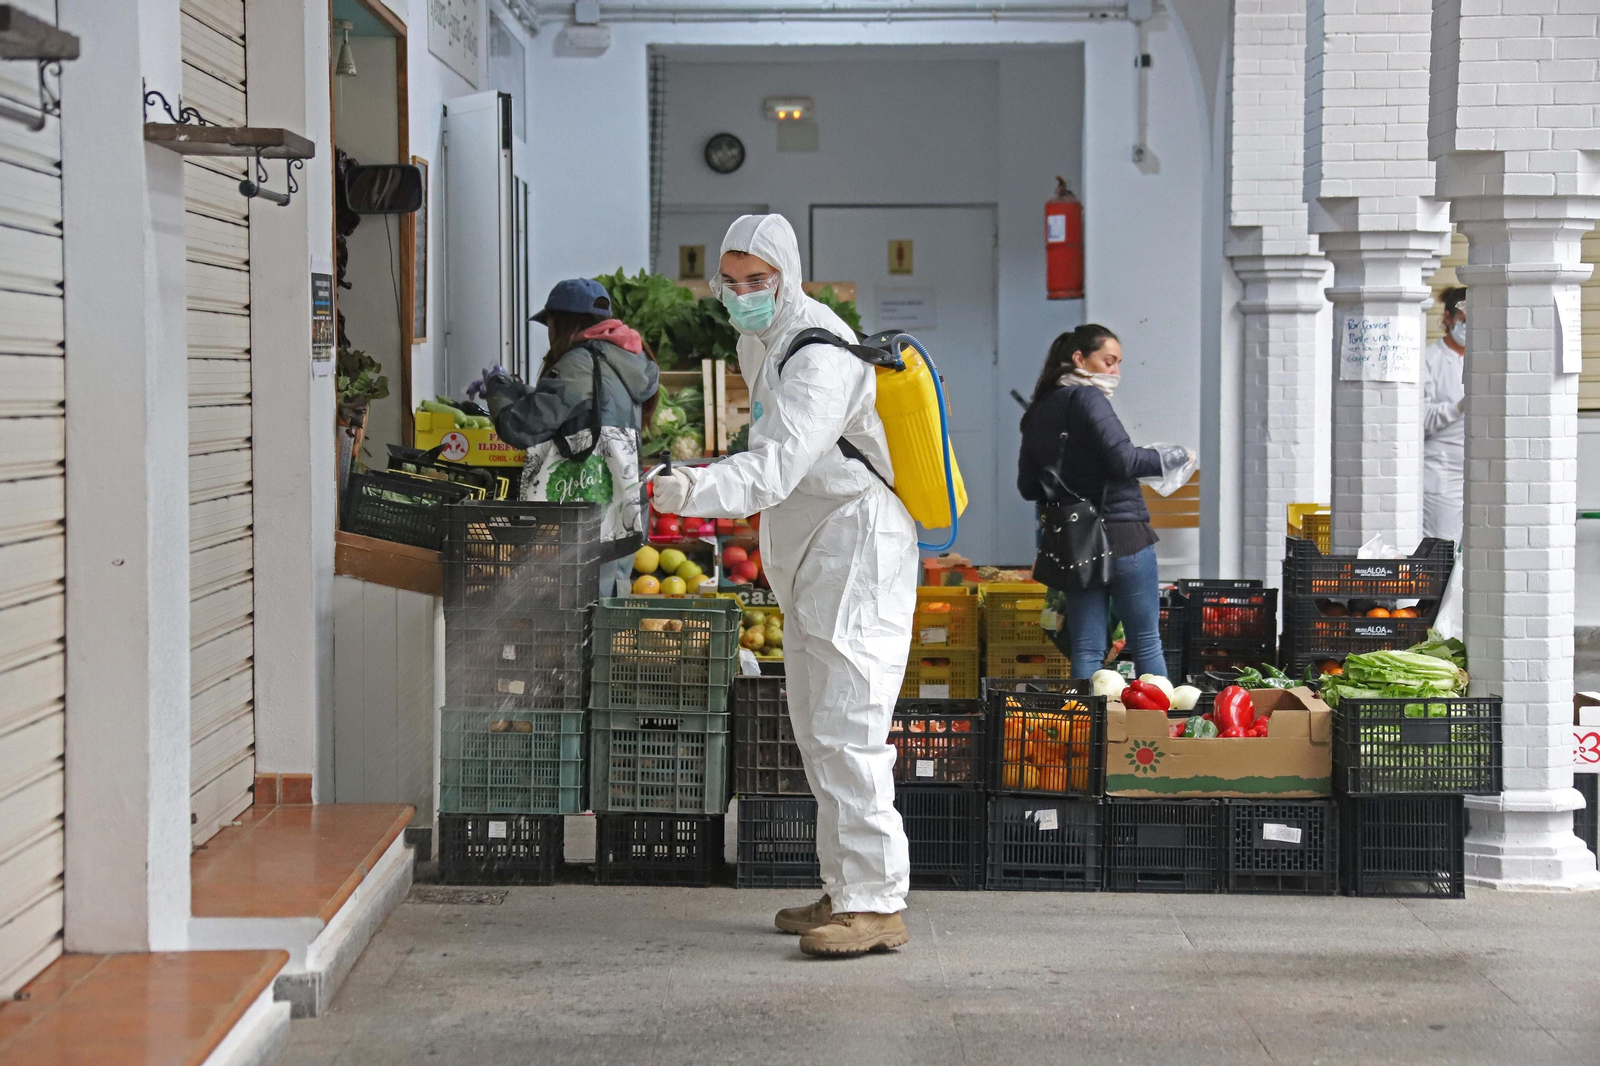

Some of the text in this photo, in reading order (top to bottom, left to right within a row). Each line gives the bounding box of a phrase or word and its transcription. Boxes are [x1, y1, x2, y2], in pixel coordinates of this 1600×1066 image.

[1360, 320, 1390, 335] favor
[555, 463, 603, 505] Hola!
[1367, 566, 1387, 574] ALOA
